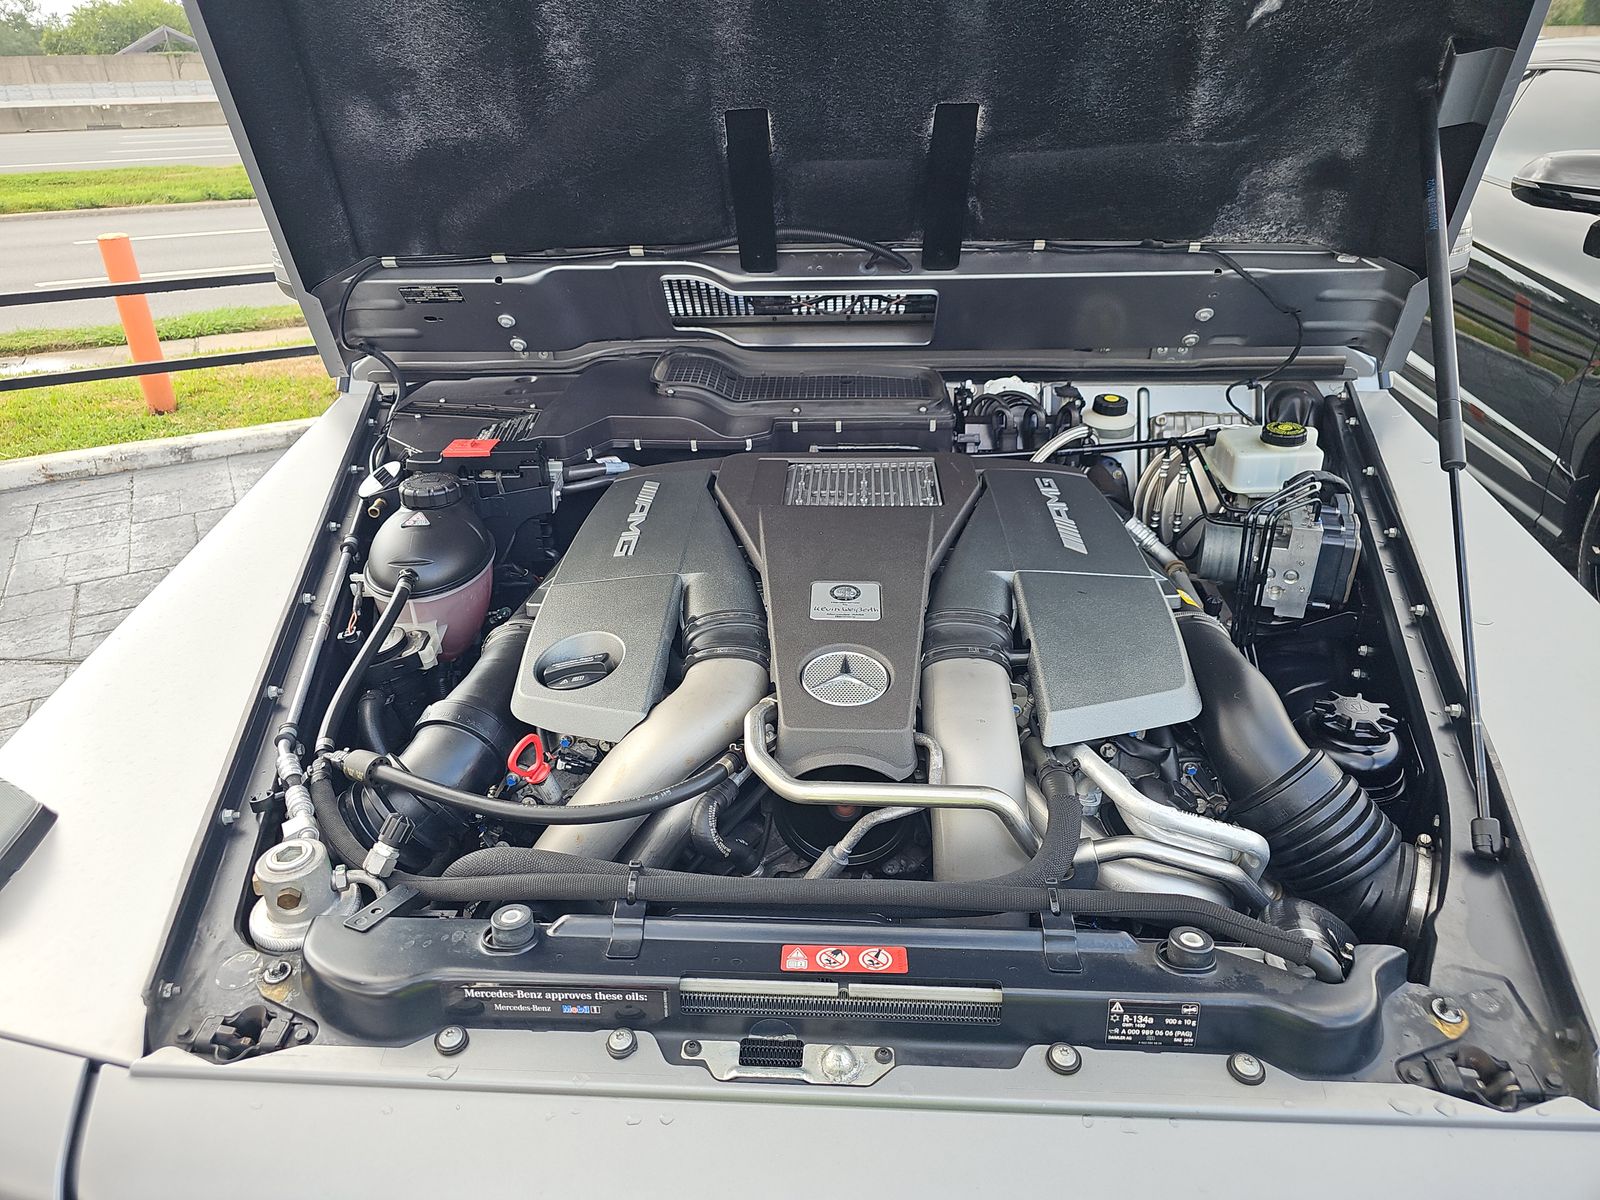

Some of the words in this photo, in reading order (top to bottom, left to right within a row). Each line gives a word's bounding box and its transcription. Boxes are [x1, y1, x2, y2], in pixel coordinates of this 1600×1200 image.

[464, 989, 543, 1000] Mercedes-Benz
[545, 991, 592, 1002] approves
[594, 991, 623, 1001] these
[625, 991, 648, 1002] oils:
[494, 1003, 551, 1012] Mercedes-Benz
[562, 1004, 590, 1013] Mobil
[1123, 1015, 1154, 1024] R-134a
